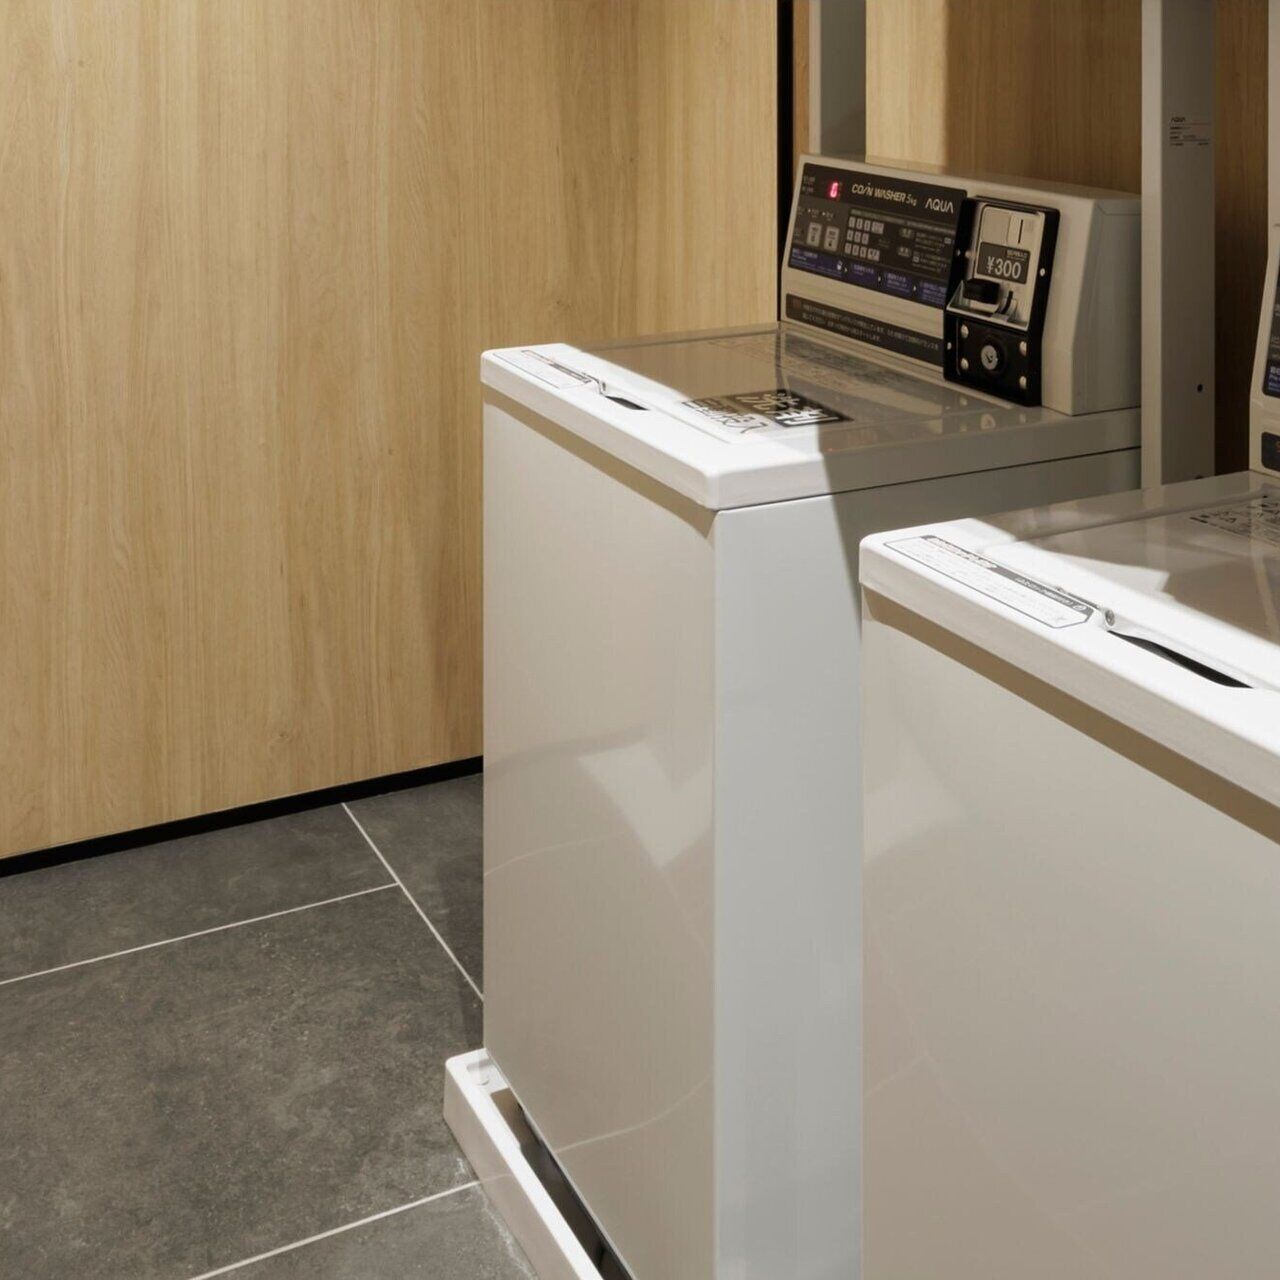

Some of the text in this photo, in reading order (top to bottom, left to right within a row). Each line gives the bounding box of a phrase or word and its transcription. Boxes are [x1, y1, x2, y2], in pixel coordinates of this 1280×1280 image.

[874, 187, 906, 202] WASHER
[924, 197, 954, 214] AQUA
[986, 255, 1022, 280] ¥300
